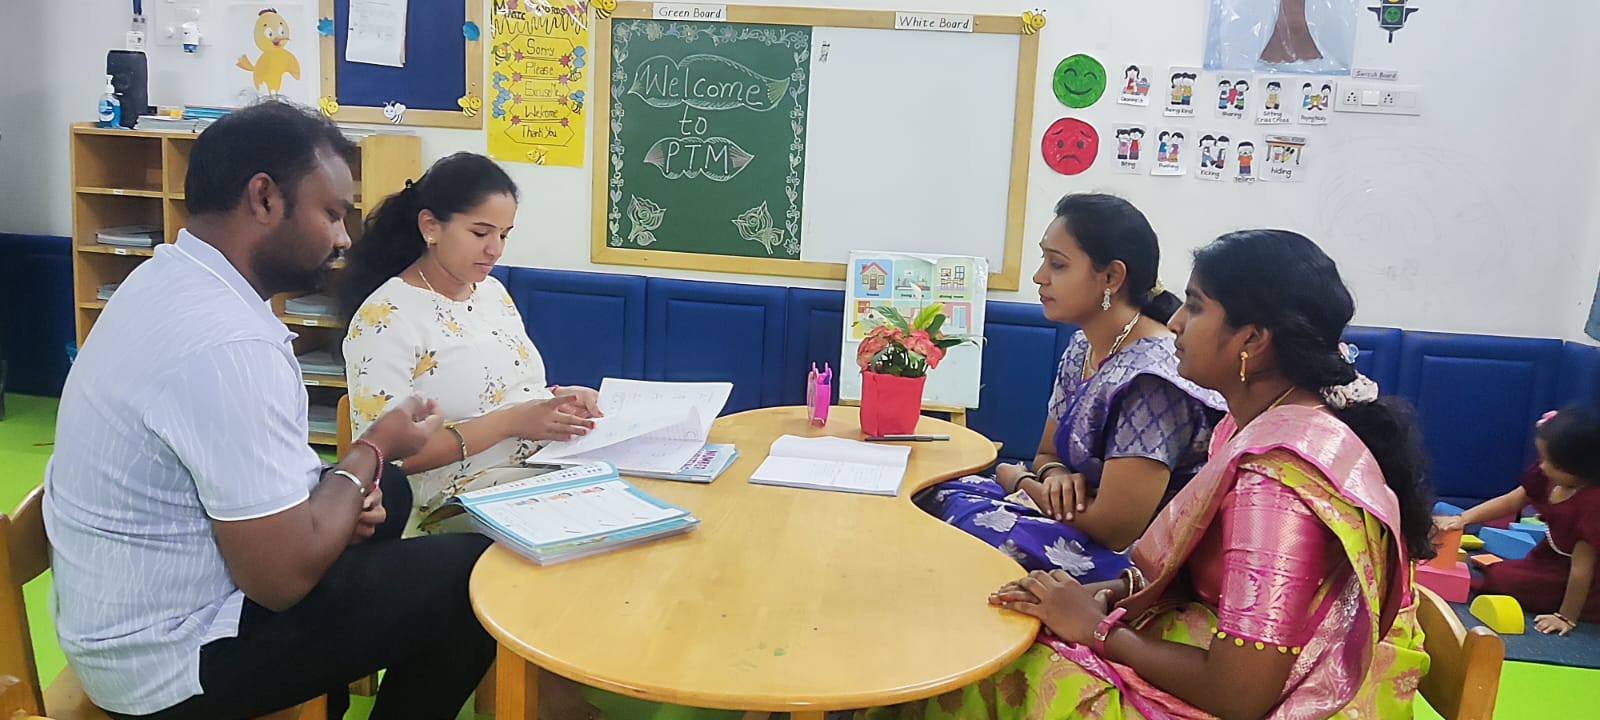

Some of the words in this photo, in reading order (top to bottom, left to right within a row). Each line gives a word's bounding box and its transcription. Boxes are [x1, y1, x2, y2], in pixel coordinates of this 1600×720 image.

[659, 6, 690, 17] Green
[693, 7, 722, 18] Board
[899, 15, 935, 27] White
[939, 17, 970, 29] Board
[526, 38, 555, 56] Sorry
[525, 62, 554, 76] Please
[640, 64, 764, 106] Welcome
[525, 104, 558, 118] Welcome
[679, 105, 708, 136] to
[521, 124, 543, 138] Thank
[543, 126, 558, 138] You
[666, 141, 729, 175] PTM
[1271, 166, 1293, 179] hiding
